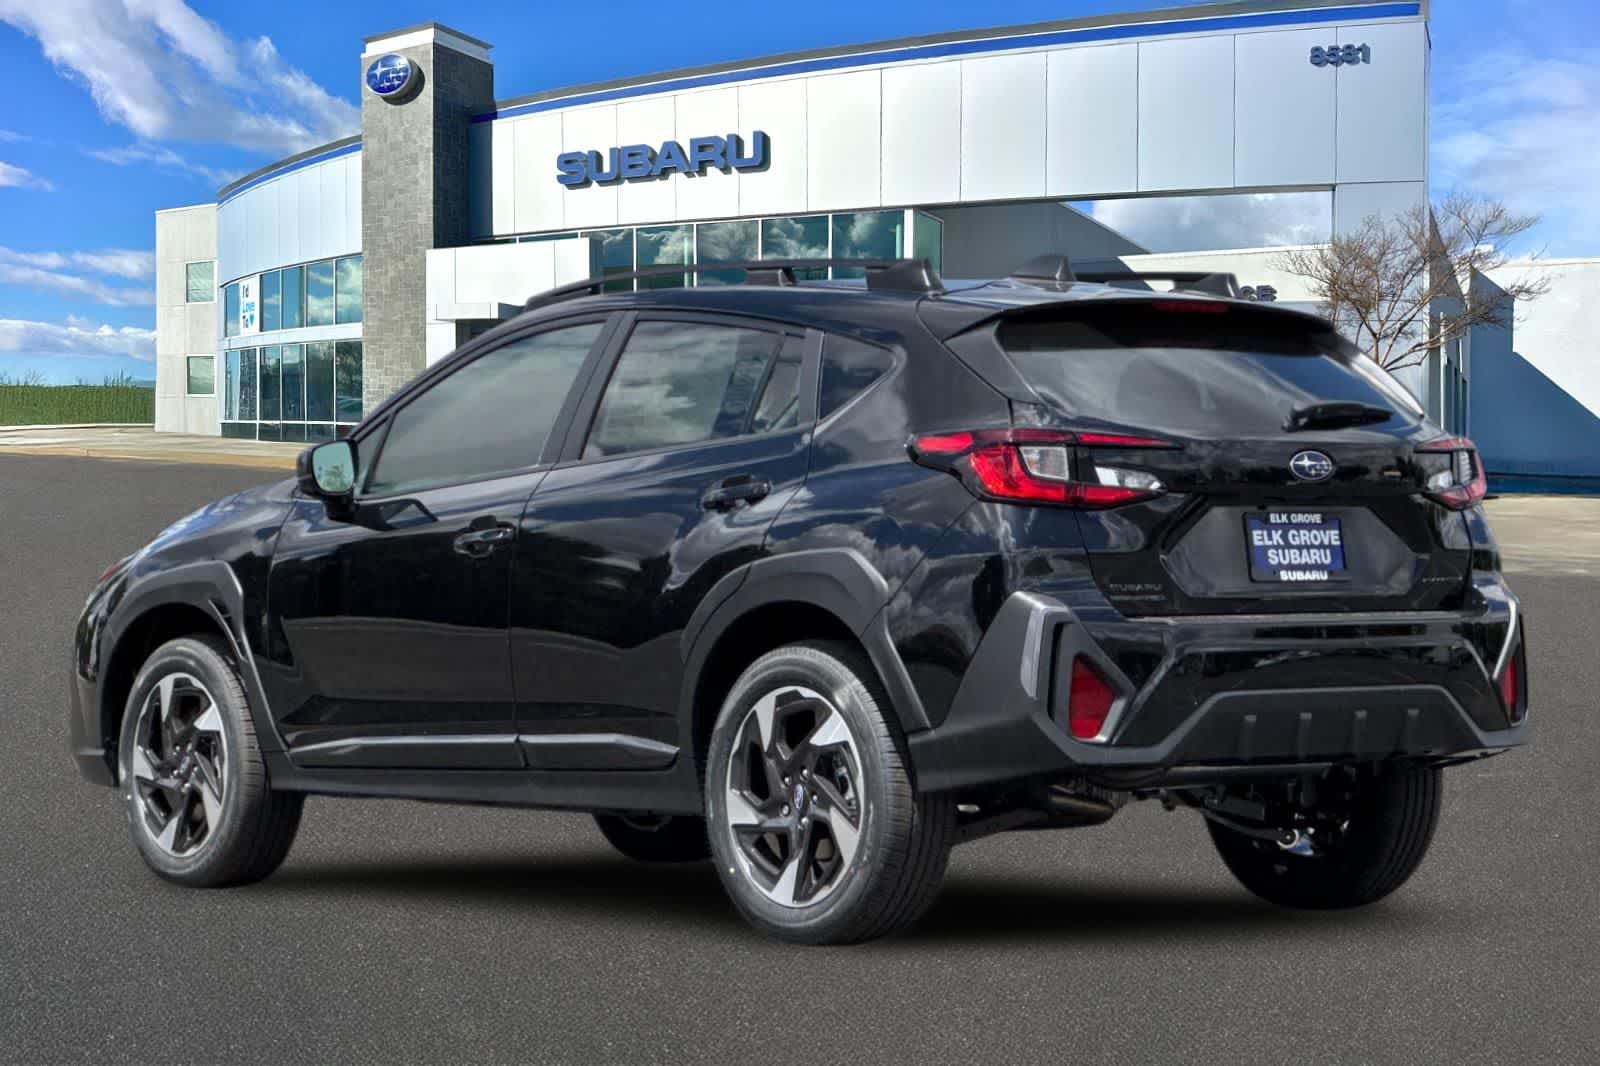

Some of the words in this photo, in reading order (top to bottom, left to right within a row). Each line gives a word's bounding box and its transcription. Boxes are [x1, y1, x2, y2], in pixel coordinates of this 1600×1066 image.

[556, 130, 770, 190] SUBARU
[1269, 513, 1289, 524] ELK
[1290, 513, 1322, 524] GROVE
[1252, 529, 1284, 546] ELK
[1287, 529, 1341, 546] GROVE
[1267, 548, 1332, 565] SUBARU
[1280, 570, 1328, 581] SUBARU
